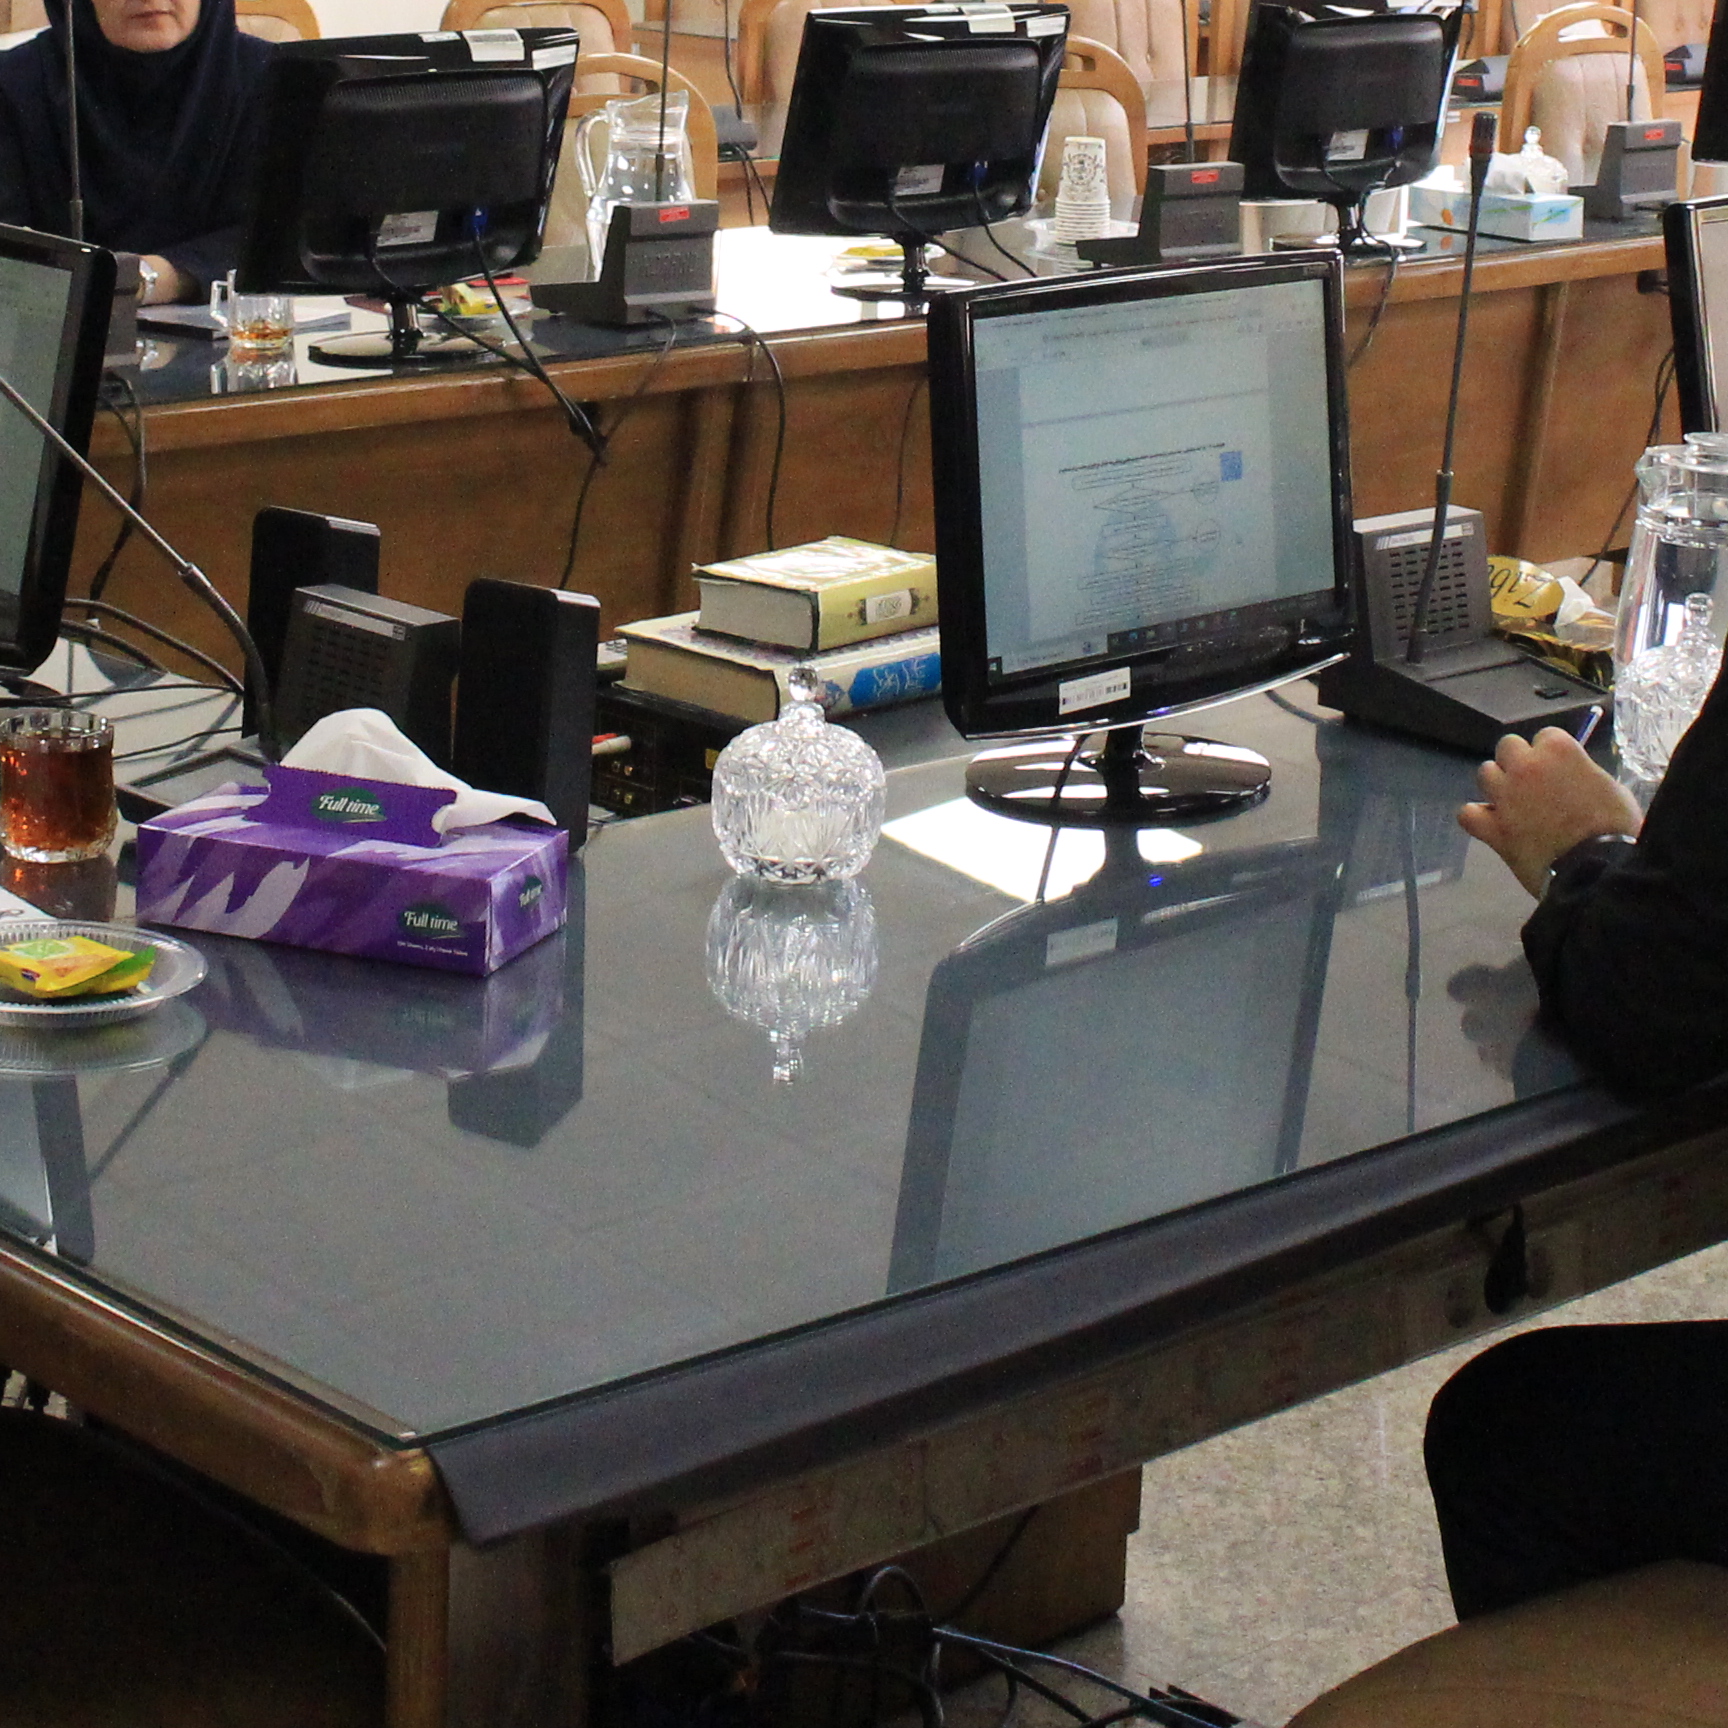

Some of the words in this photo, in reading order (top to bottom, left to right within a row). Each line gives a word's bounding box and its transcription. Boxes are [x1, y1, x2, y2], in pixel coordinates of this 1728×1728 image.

[318, 794, 348, 813] Full
[346, 798, 380, 815] time
[404, 910, 429, 928] Full
[429, 915, 459, 932] time
